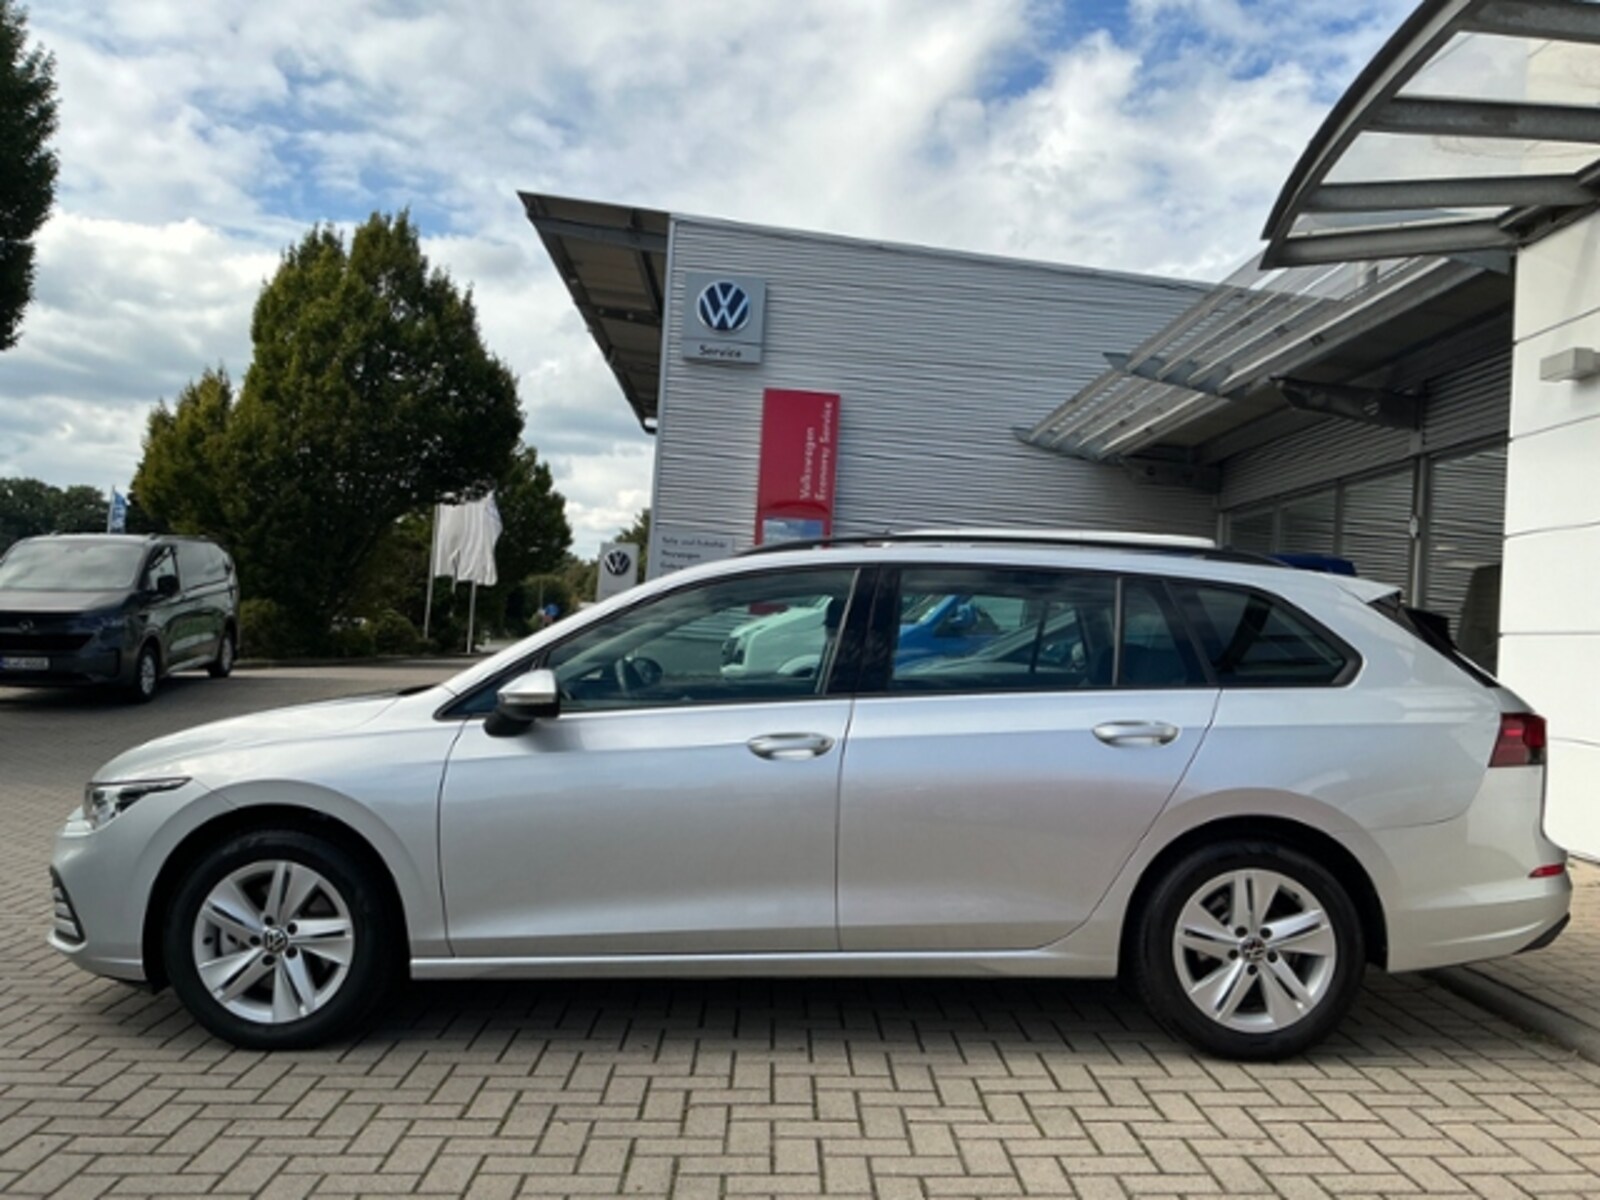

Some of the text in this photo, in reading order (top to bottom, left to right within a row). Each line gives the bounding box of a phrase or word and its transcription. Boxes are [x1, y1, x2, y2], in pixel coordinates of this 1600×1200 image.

[699, 344, 742, 358] Service
[819, 401, 833, 444] Service
[800, 427, 816, 500] Volkswagen
